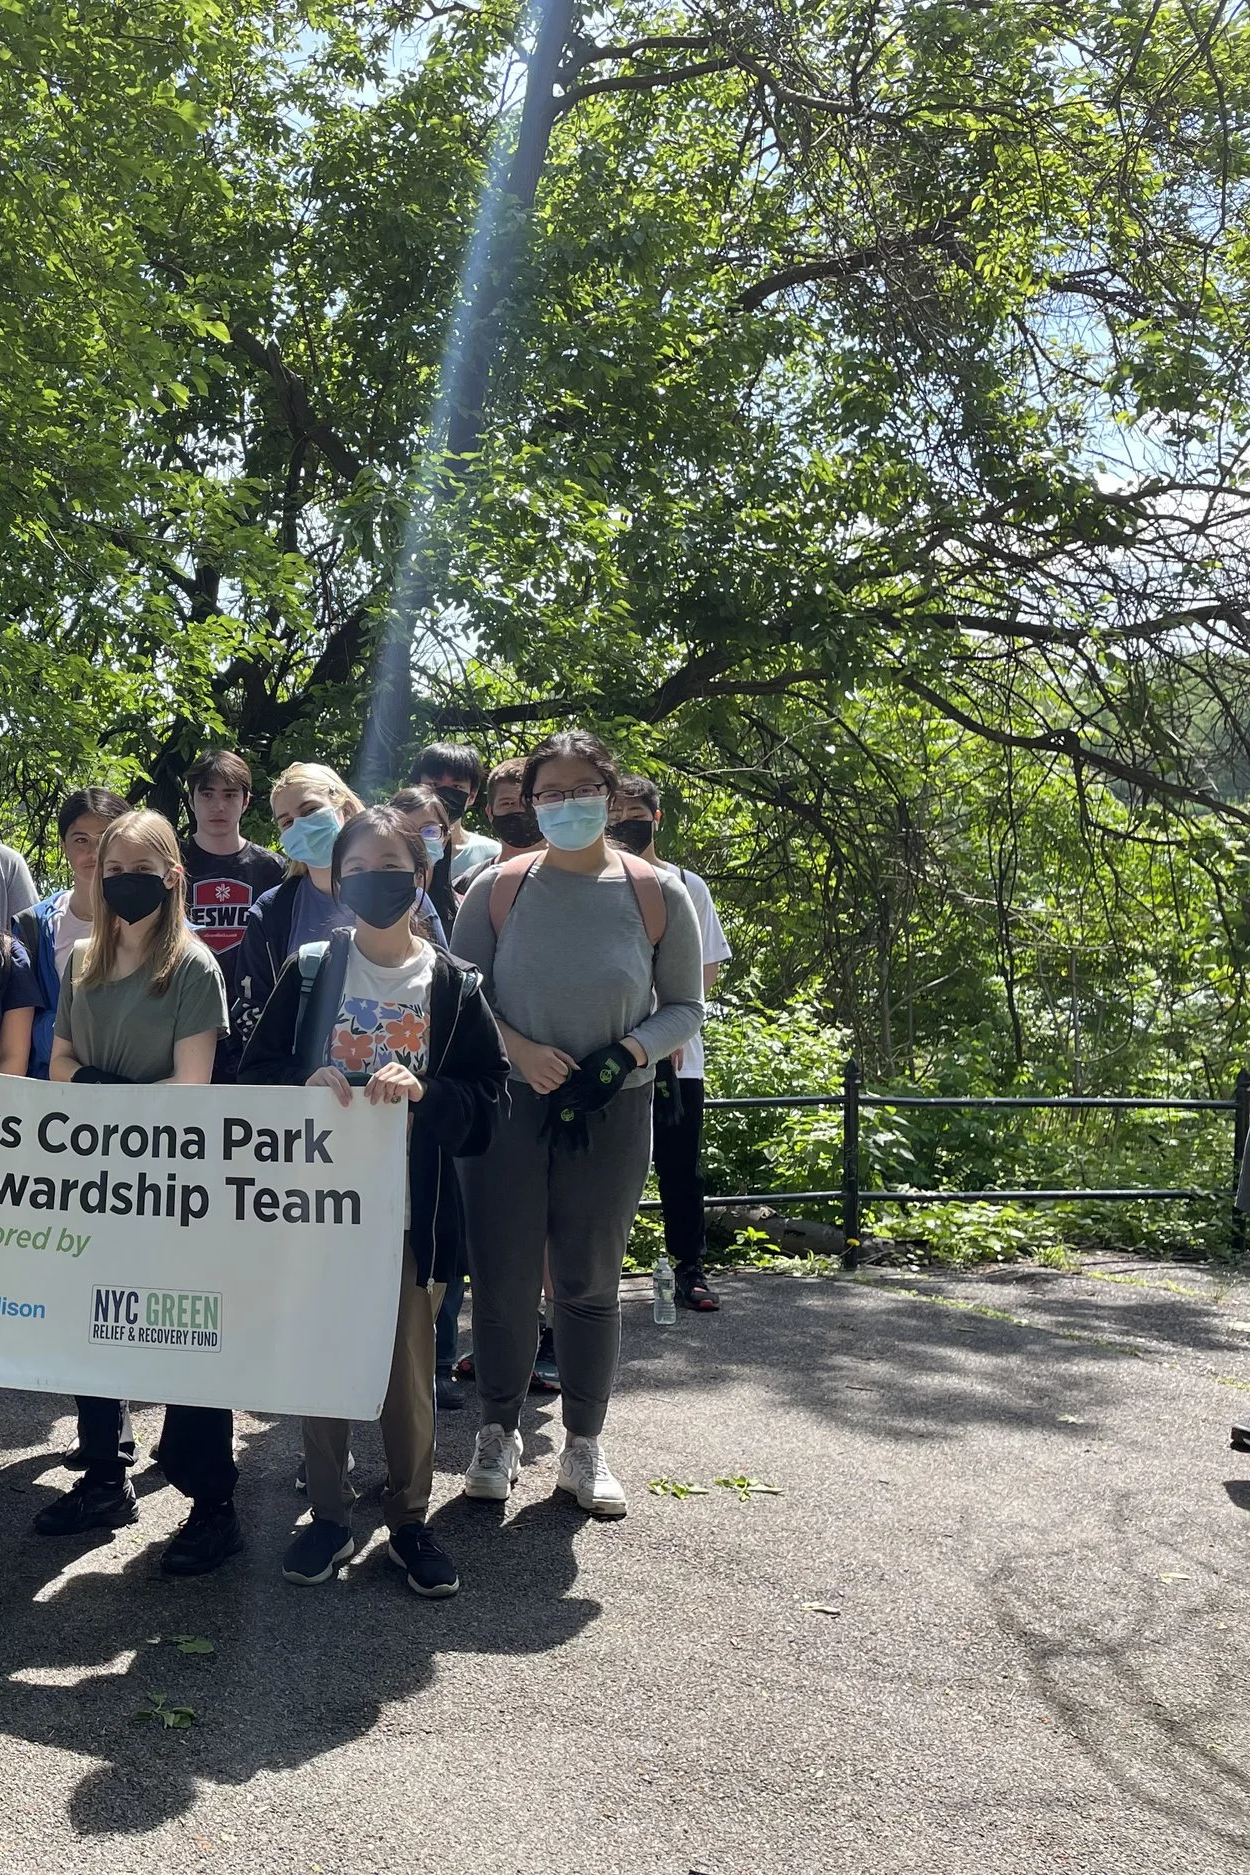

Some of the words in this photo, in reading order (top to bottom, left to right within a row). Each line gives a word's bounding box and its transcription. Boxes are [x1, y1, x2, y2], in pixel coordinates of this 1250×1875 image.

[37, 1112, 206, 1160] Corona
[222, 1117, 333, 1164] Park
[225, 1177, 362, 1225] Team
[56, 1228, 91, 1258] by
[94, 1289, 139, 1325] NYC
[146, 1292, 219, 1330] GREEN
[92, 1324, 126, 1341] RELIEF
[127, 1327, 136, 1342] &
[138, 1327, 189, 1346] RECOVERY
[191, 1331, 218, 1347] FUND
